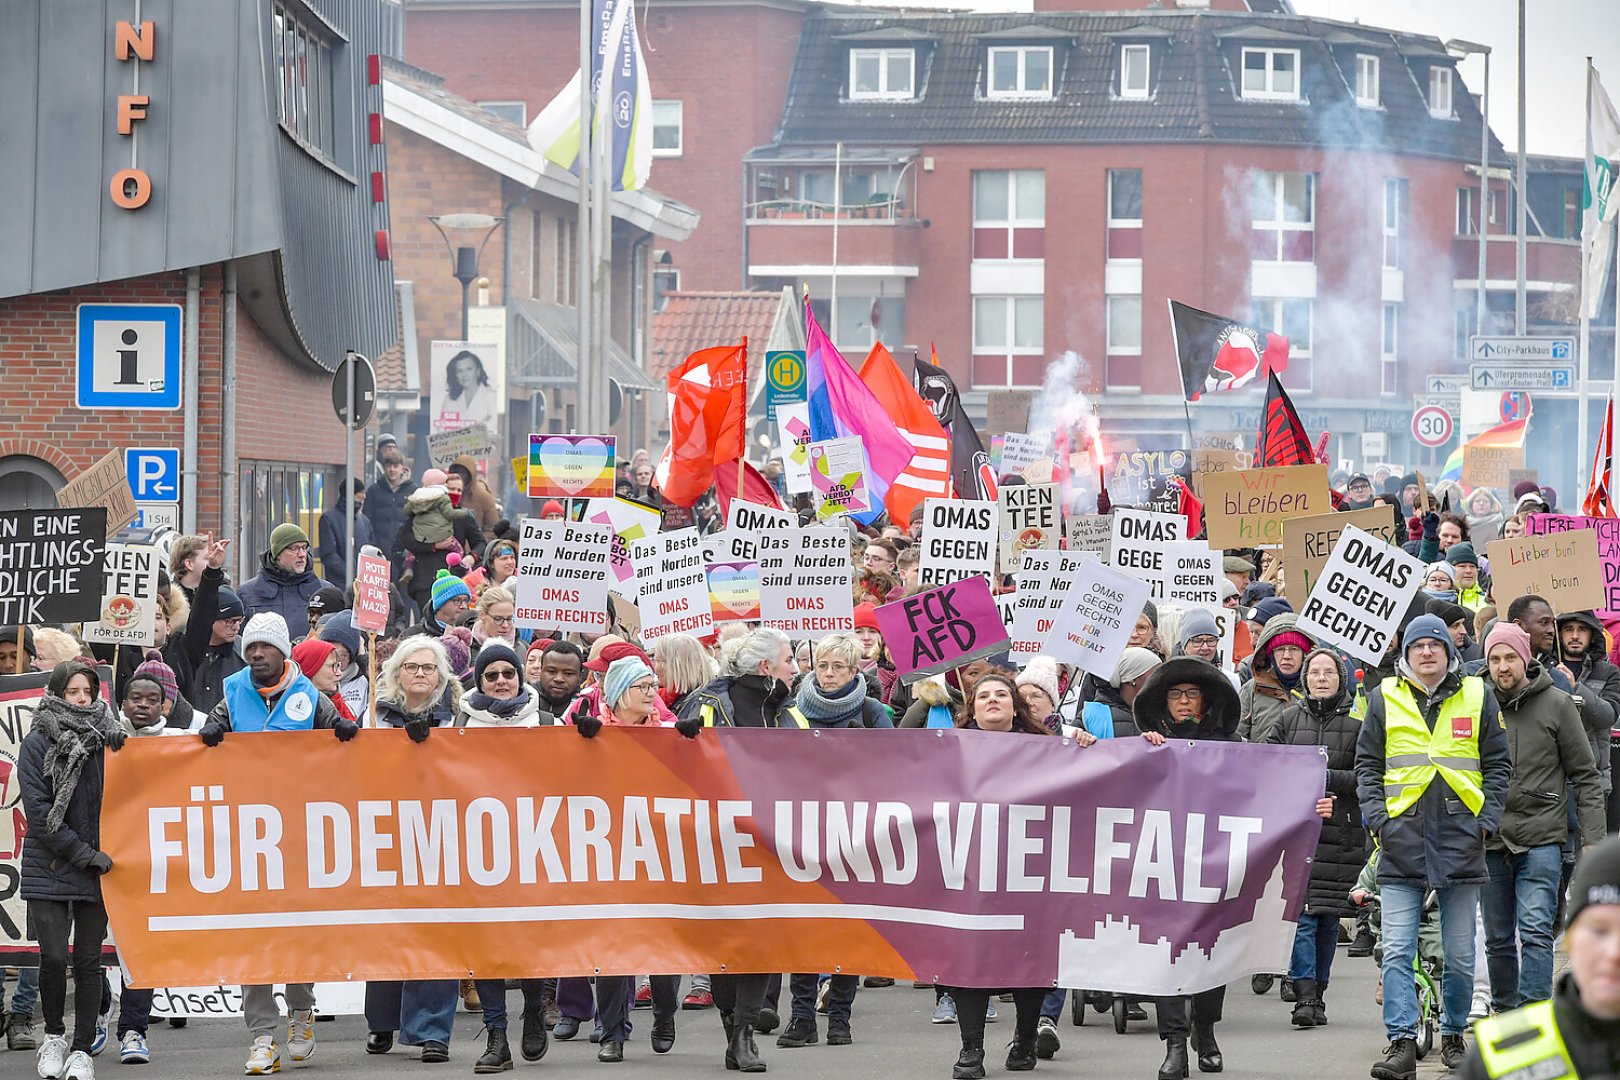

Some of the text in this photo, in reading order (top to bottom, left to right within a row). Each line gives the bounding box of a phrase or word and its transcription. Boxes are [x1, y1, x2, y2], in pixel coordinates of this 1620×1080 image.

[1496, 345, 1550, 356] City-Parkhaus
[780, 362, 794, 381] H
[1495, 370, 1551, 380] Uferpromenade
[1421, 418, 1444, 435] 30
[139, 455, 166, 495] P
[1137, 476, 1157, 490] ist
[1240, 471, 1285, 491] Wir
[1470, 470, 1509, 483] RECHT
[822, 489, 855, 501] VERBOT
[829, 484, 847, 493] AFD
[1006, 487, 1052, 506] KIEN
[828, 497, 852, 507] JETZT
[34, 515, 81, 537] EINE
[155, 514, 172, 524] Std.
[736, 508, 790, 531] OMAS
[933, 506, 991, 530] OMAS
[1006, 506, 1053, 530] TEE
[524, 526, 608, 544] Das Beste
[1120, 517, 1177, 541] OMAS
[611, 534, 627, 545] FD
[635, 544, 656, 560] Das
[666, 536, 698, 553] Beste
[761, 536, 789, 550] Das
[802, 536, 846, 549] Beste
[521, 547, 544, 559] am
[554, 547, 606, 563] Norden
[930, 539, 988, 560] GEGEN
[1510, 544, 1550, 566] Lieber
[104, 551, 150, 571] KIEN
[365, 562, 387, 575] ROTE
[637, 567, 653, 578] am
[662, 554, 700, 572] Norden
[761, 555, 845, 568] am Norden
[1023, 557, 1050, 571] Das
[1118, 548, 1163, 571] GEGE
[1177, 558, 1211, 569] OMAS
[1343, 538, 1413, 589] OMAS
[363, 573, 388, 589] KARTE
[520, 564, 606, 581] sind unsere
[762, 573, 848, 586] sind unsere
[1174, 575, 1214, 586] GEGEN
[102, 572, 149, 599] TEE
[368, 586, 383, 600] FÜR
[640, 579, 662, 596] sind
[667, 573, 704, 591] unsere
[1020, 577, 1072, 591] am Nor
[1092, 583, 1125, 603] OMAS
[1526, 574, 1580, 595] als braun
[542, 588, 580, 603] OMAS
[786, 597, 824, 610] OMAS
[1018, 595, 1047, 609] sind
[1083, 593, 1123, 616] GEGEN
[1171, 591, 1217, 602] RECHTS
[1327, 571, 1397, 621] GEGEN
[361, 600, 387, 615] NAZIS
[517, 607, 605, 625] GEGEN RECHTS
[659, 598, 688, 616] OMAS
[903, 587, 961, 633] FCK
[763, 617, 853, 631] GEGEN RECHTS
[1075, 605, 1121, 629] RECHTS
[1304, 597, 1387, 653] RECHTS
[114, 630, 125, 638] DE
[127, 630, 147, 639] AFD!
[644, 623, 671, 640] GEGEN
[673, 613, 712, 633] RECHTS
[1082, 623, 1101, 638] FÜR
[912, 618, 976, 669] AFD
[1012, 641, 1042, 653] GEGE
[1067, 632, 1105, 654] VIELFALT
[148, 785, 1264, 904] FÜR DEMOKRATIE UND VIELFALT
